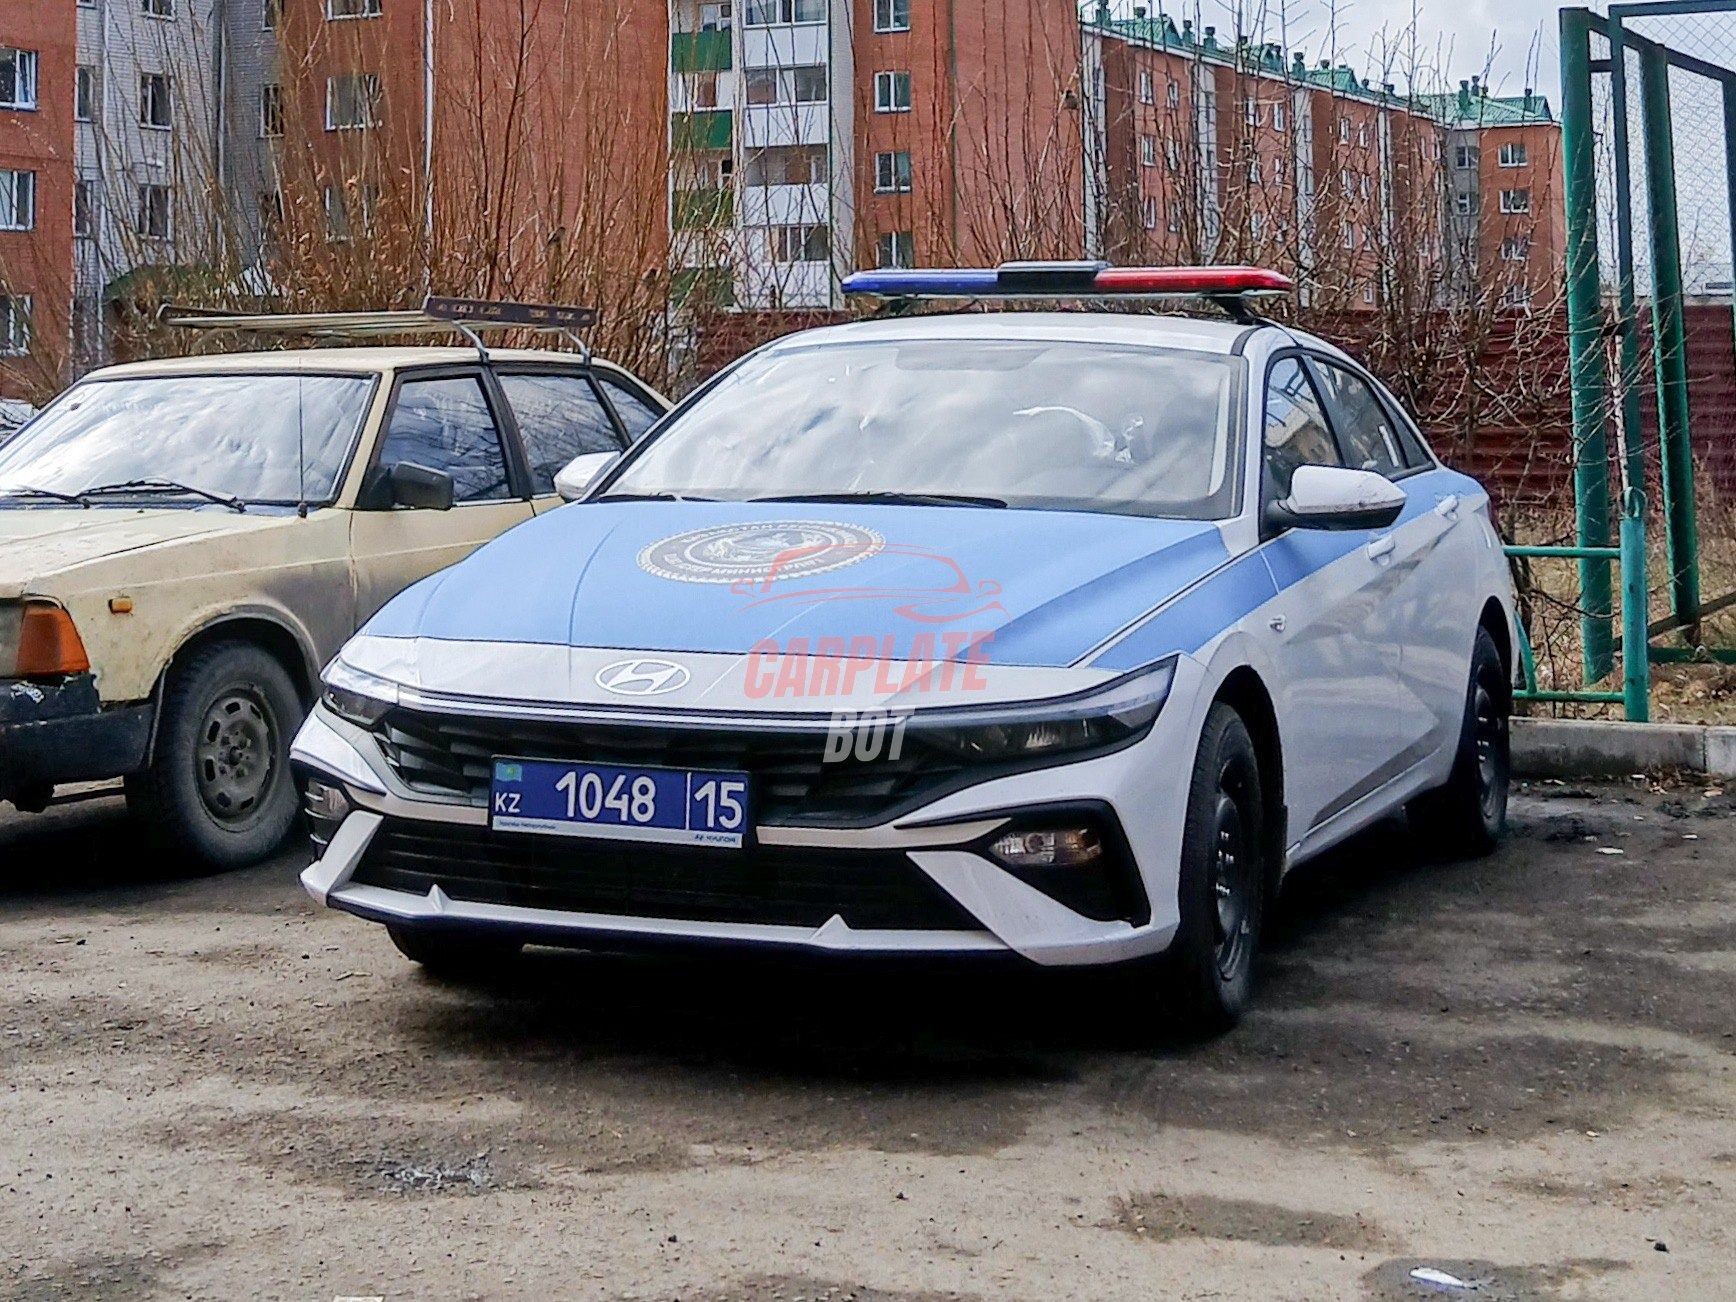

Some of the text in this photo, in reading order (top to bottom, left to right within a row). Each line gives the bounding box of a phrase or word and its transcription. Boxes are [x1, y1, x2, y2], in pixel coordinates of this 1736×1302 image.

[494, 792, 521, 813] KZ
[555, 770, 746, 829] 1048 15
